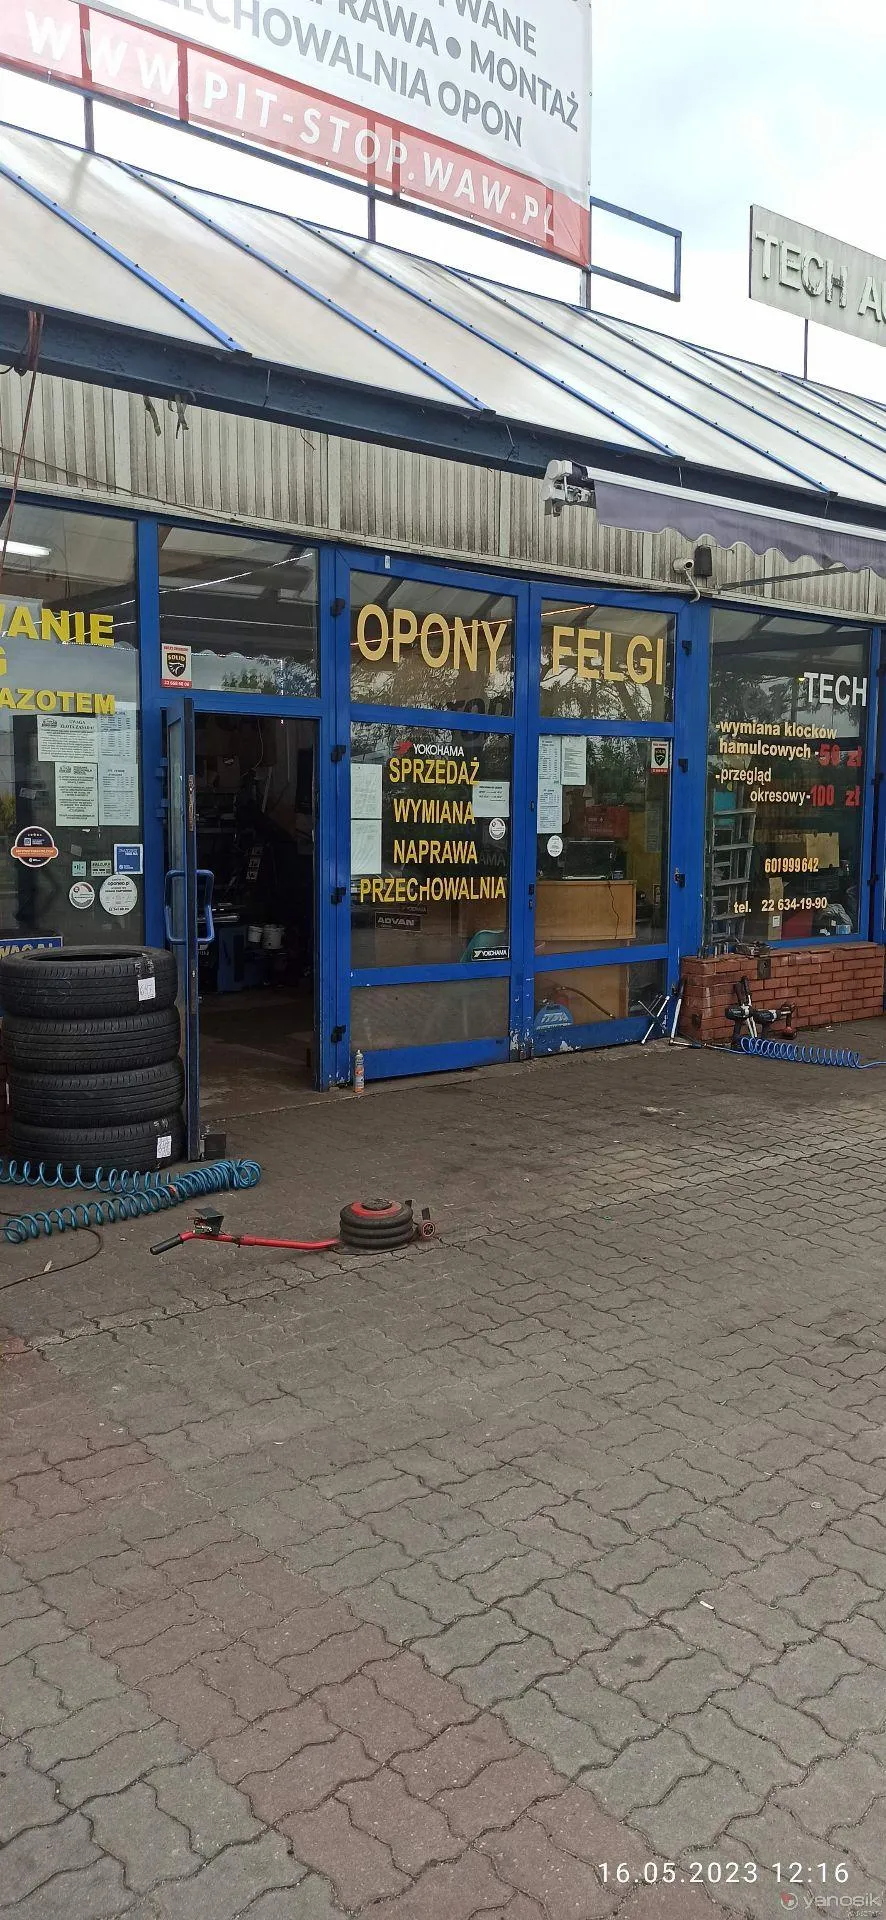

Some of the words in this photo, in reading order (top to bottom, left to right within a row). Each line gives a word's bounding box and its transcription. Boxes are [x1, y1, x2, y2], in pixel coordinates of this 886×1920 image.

[438, 0, 537, 57] WANE
[470, 40, 579, 132] MONTAŻ
[25, 8, 556, 237] WWW.PIT-STOP.WAW.PL
[438, 81, 523, 147] OPON
[755, 230, 849, 308] TECH
[0, 603, 115, 646] ANIE
[356, 603, 508, 674] OPONY
[552, 625, 664, 685] FELGI
[0, 687, 116, 715] AZOTEM
[803, 671, 868, 707] TECH
[784, 721, 837, 740] klocków
[413, 743, 465, 758] YOKOHAMA
[719, 737, 811, 761] hamulcowych
[846, 745, 863, 767] zł
[389, 756, 480, 786] SPRZEDAŻ
[845, 785, 861, 807] zł
[393, 799, 476, 825] WYMIANA
[393, 839, 478, 864] NAPRAWA
[360, 876, 507, 903] PRZECHOWALNIA
[734, 901, 752, 913] tel.
[761, 900, 775, 912] 22
[777, 897, 828, 911] 634-19-90
[378, 916, 415, 926] ADVAN
[481, 949, 508, 957] YOKOHAMA
